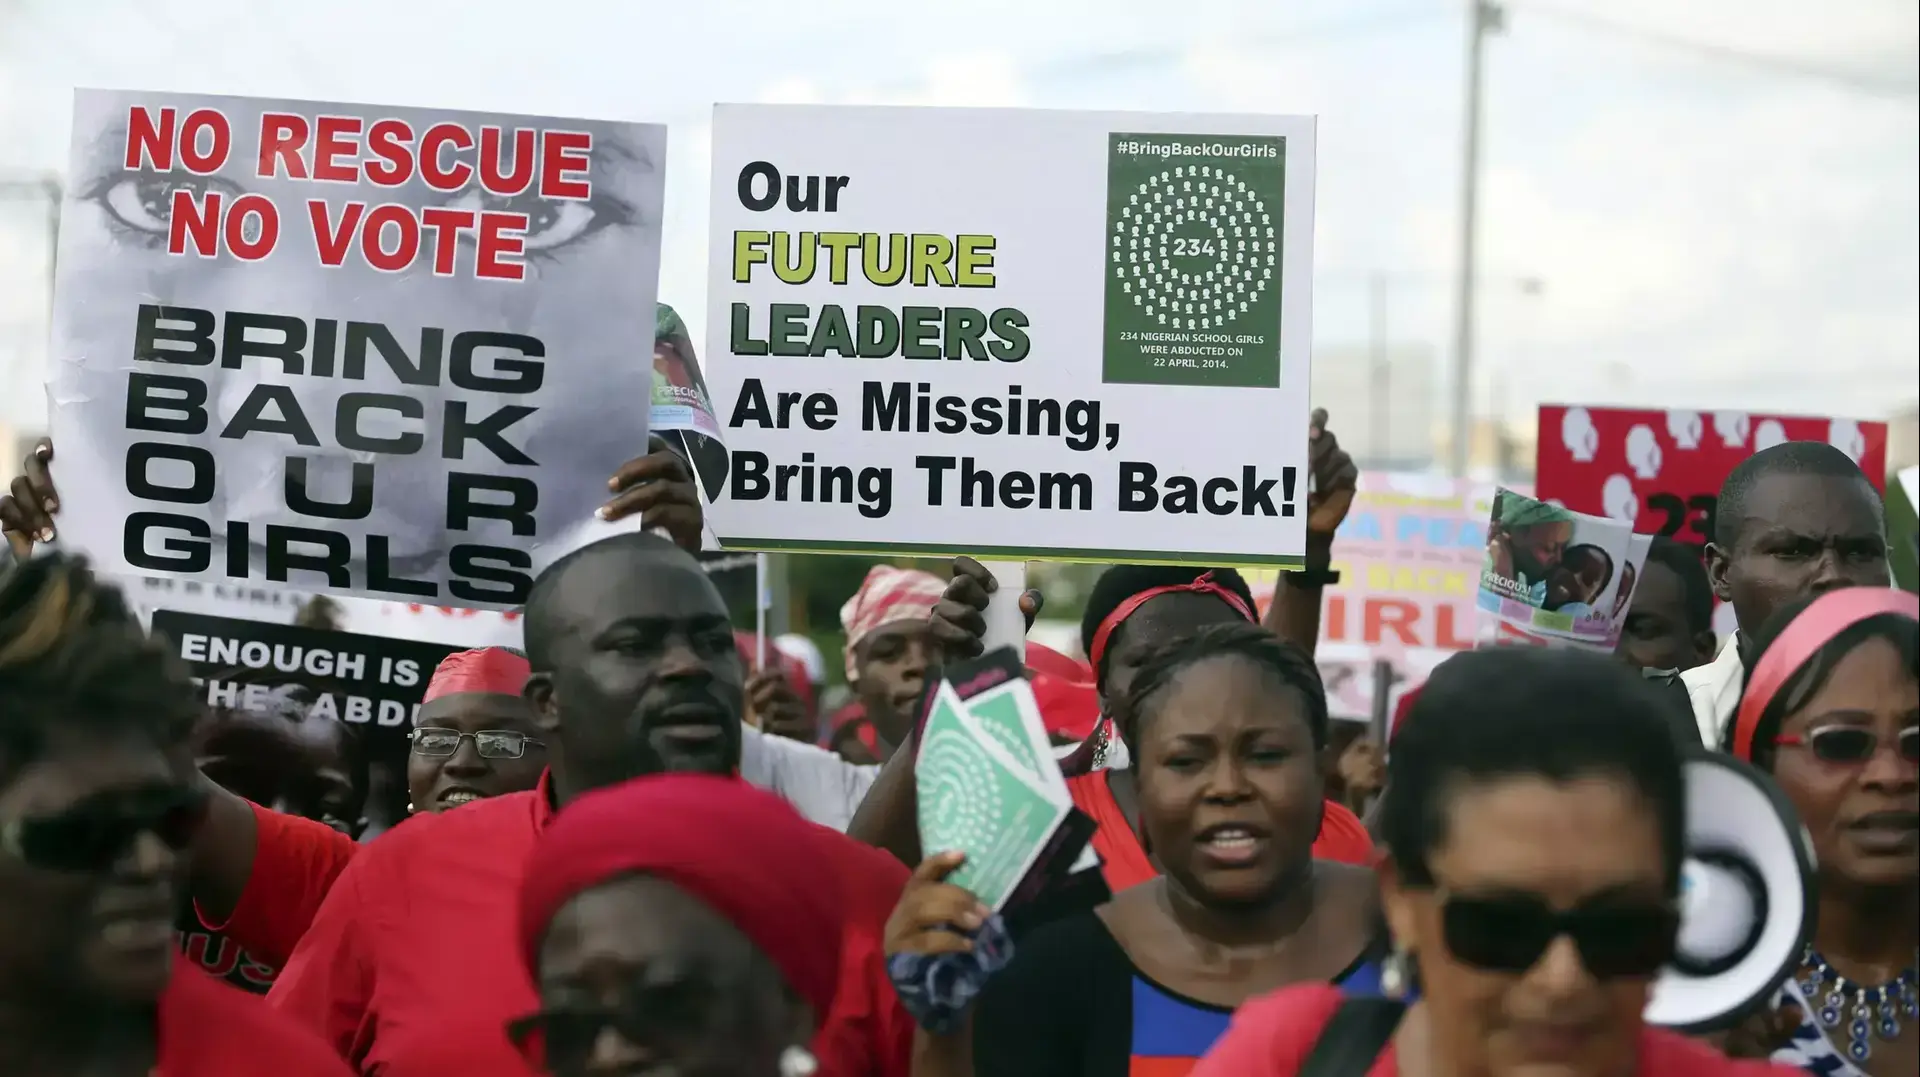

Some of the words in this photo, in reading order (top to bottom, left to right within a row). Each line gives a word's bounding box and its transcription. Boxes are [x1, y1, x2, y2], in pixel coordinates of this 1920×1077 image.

[125, 105, 231, 174] NO
[256, 113, 592, 201] RESCUE
[1117, 141, 1277, 158] #BringBackOurGirls
[737, 160, 850, 213] Our
[167, 190, 280, 261] NO
[305, 199, 529, 280] VOTE
[732, 230, 996, 288] FUTURE
[1173, 237, 1216, 257] 234
[134, 303, 546, 394] BRING
[730, 302, 1030, 363] LEADERS
[1119, 331, 1138, 341] 234
[1140, 332, 1190, 343] NIGERIAN
[1192, 333, 1234, 344] SCHOOL
[1235, 334, 1264, 345] GIRLS
[1139, 344, 1169, 355] WERE
[1170, 345, 1225, 356] ABDUCTED
[1227, 347, 1243, 357] ON
[1153, 357, 1166, 367] 22
[1168, 358, 1200, 369] APRIL,
[1202, 359, 1229, 369] 2014.
[126, 372, 541, 467] BACK
[729, 378, 838, 430] Are
[861, 380, 1121, 451] Missing,
[730, 451, 892, 518] Bring
[916, 455, 1093, 510] Them
[1118, 461, 1297, 518] Back!
[1646, 492, 1717, 542] 23
[124, 512, 534, 605] GIRLS
[181, 633, 366, 681] ENOUGH
[380, 657, 419, 687] IS
[190, 676, 269, 711] HE
